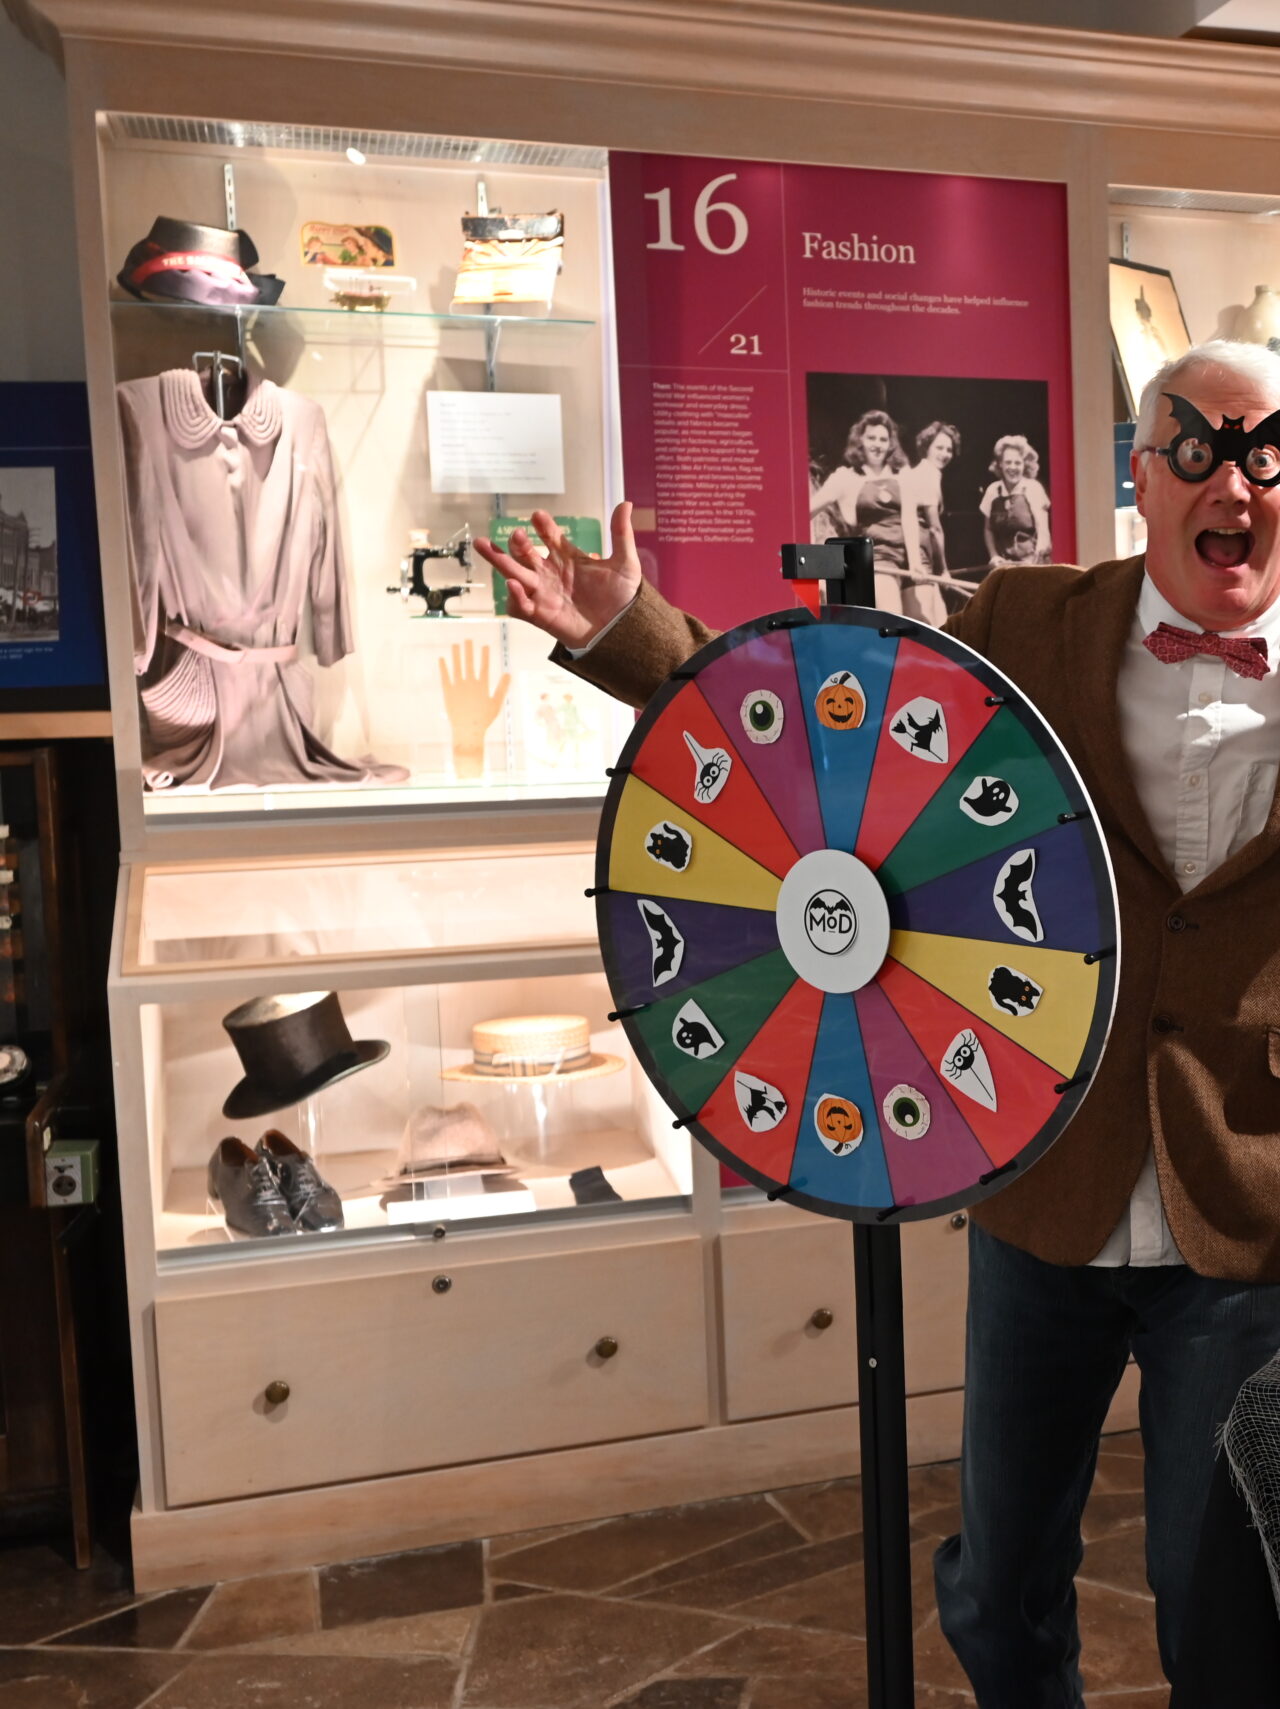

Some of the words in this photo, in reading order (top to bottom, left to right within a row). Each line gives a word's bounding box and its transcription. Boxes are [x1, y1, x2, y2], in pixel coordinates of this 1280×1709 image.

[644, 173, 749, 255] 16
[802, 232, 916, 264] Fashion
[730, 334, 762, 355] 21
